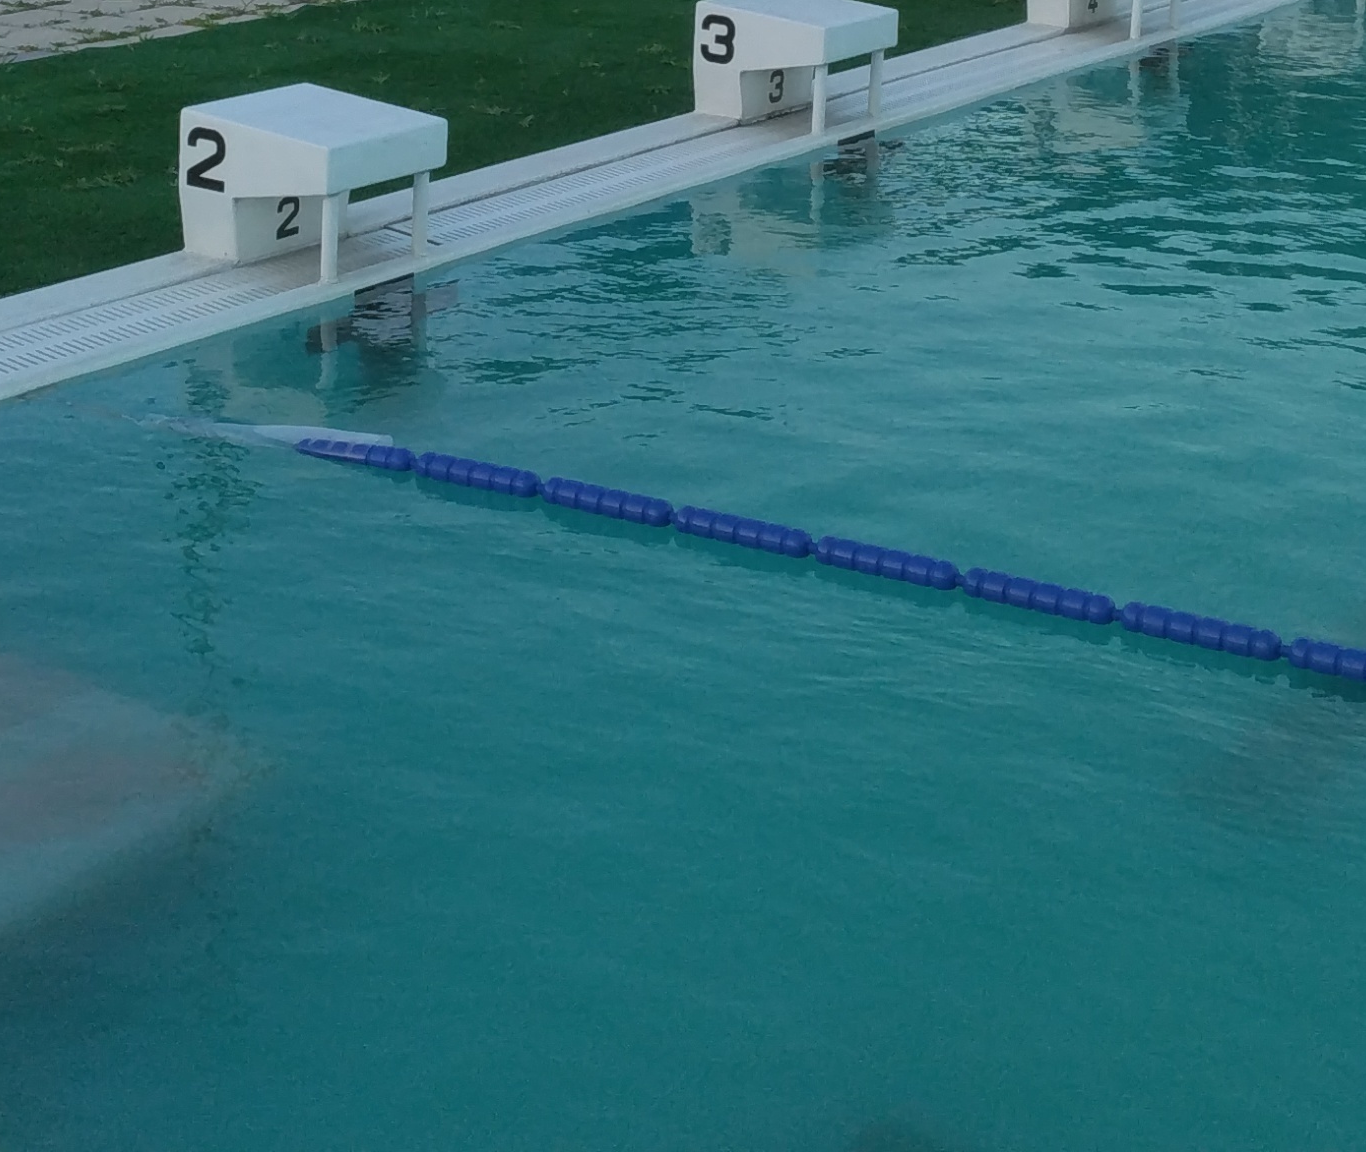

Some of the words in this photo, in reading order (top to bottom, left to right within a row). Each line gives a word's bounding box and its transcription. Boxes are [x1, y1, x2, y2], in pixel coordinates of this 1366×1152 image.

[701, 14, 735, 64] 3
[769, 69, 784, 103] 3
[187, 127, 226, 193] 2
[276, 197, 299, 240] 2
